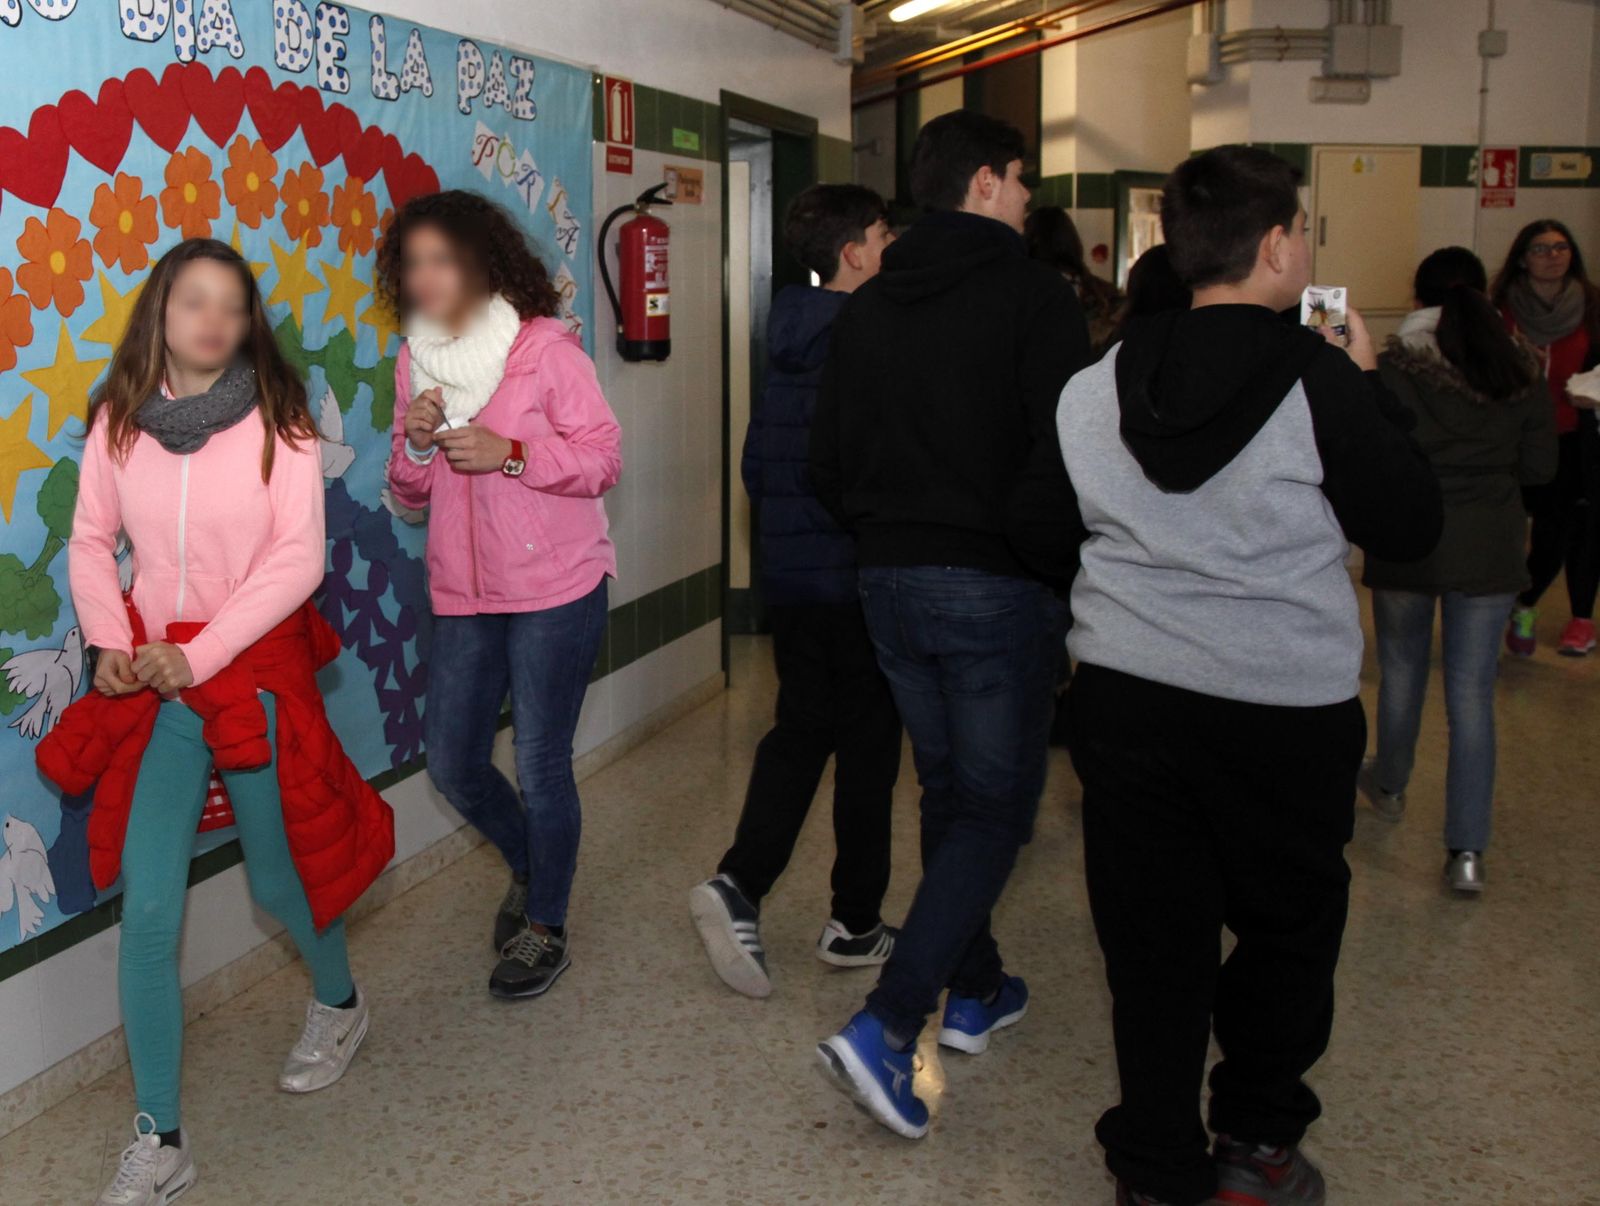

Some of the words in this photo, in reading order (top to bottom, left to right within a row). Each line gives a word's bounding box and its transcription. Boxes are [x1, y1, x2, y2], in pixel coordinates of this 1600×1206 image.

[272, 0, 351, 95] DE
[368, 14, 434, 102] LA
[456, 38, 538, 121] PAZ
